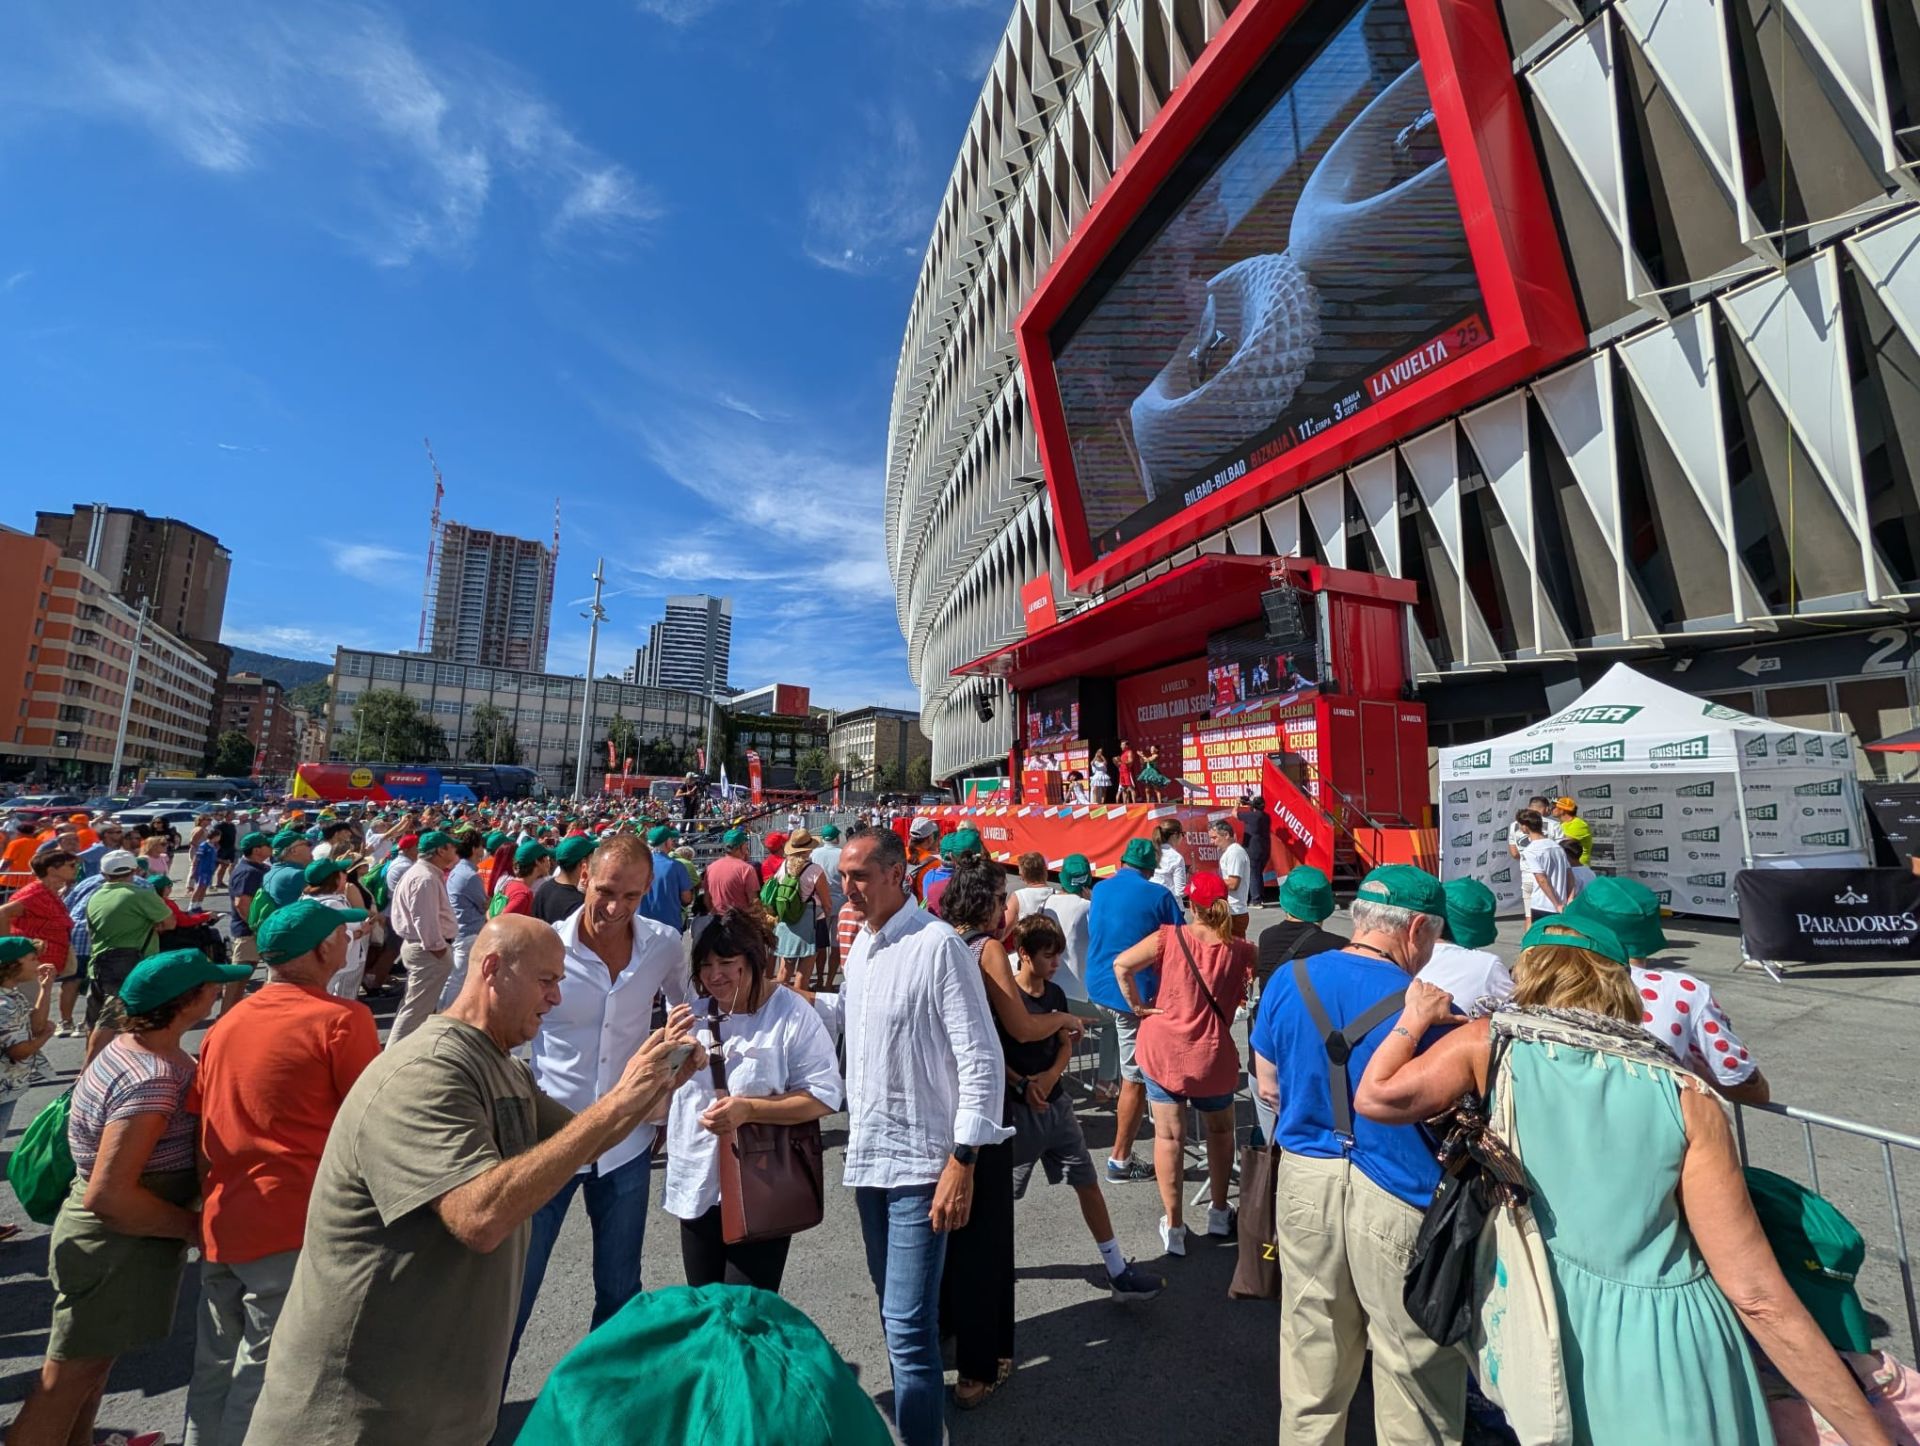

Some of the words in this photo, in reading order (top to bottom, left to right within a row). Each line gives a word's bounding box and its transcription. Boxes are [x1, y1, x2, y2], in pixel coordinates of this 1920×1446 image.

[1372, 373, 1392, 397] LA
[1390, 339, 1449, 386] VUELTA
[1457, 322, 1479, 348] 25
[1184, 459, 1247, 507] BILBAO-BILBAO
[1249, 434, 1291, 469] BIZKAIA
[1333, 402, 1343, 420] 3
[1760, 659, 1777, 670] 23
[1161, 682, 1169, 693] LA
[1168, 679, 1189, 692] VUELTA
[1137, 702, 1169, 722] CELEBRA
[1168, 697, 1189, 717] CADA
[1280, 703, 1313, 719] CELEBRA
[1203, 742, 1230, 756] CELEBRA
[1230, 739, 1248, 754] CADA
[1510, 746, 1550, 764] FINISHER
[1574, 742, 1622, 761] FINISHER
[1650, 740, 1705, 760] FINISHER
[1207, 756, 1233, 770] CELEBRA
[1235, 754, 1252, 768] CADA
[1211, 770, 1238, 784] CELEBRA
[1215, 784, 1243, 797] CELEBRA
[1795, 781, 1839, 795] FINISHER
[1273, 800, 1286, 818] LA
[1284, 811, 1314, 849] VUELTA
[989, 827, 1007, 840] VUELTA
[1802, 832, 1846, 846] FINISHER
[1796, 912, 1918, 933] PARADORES
[1845, 937, 1891, 946] Restaurantes
